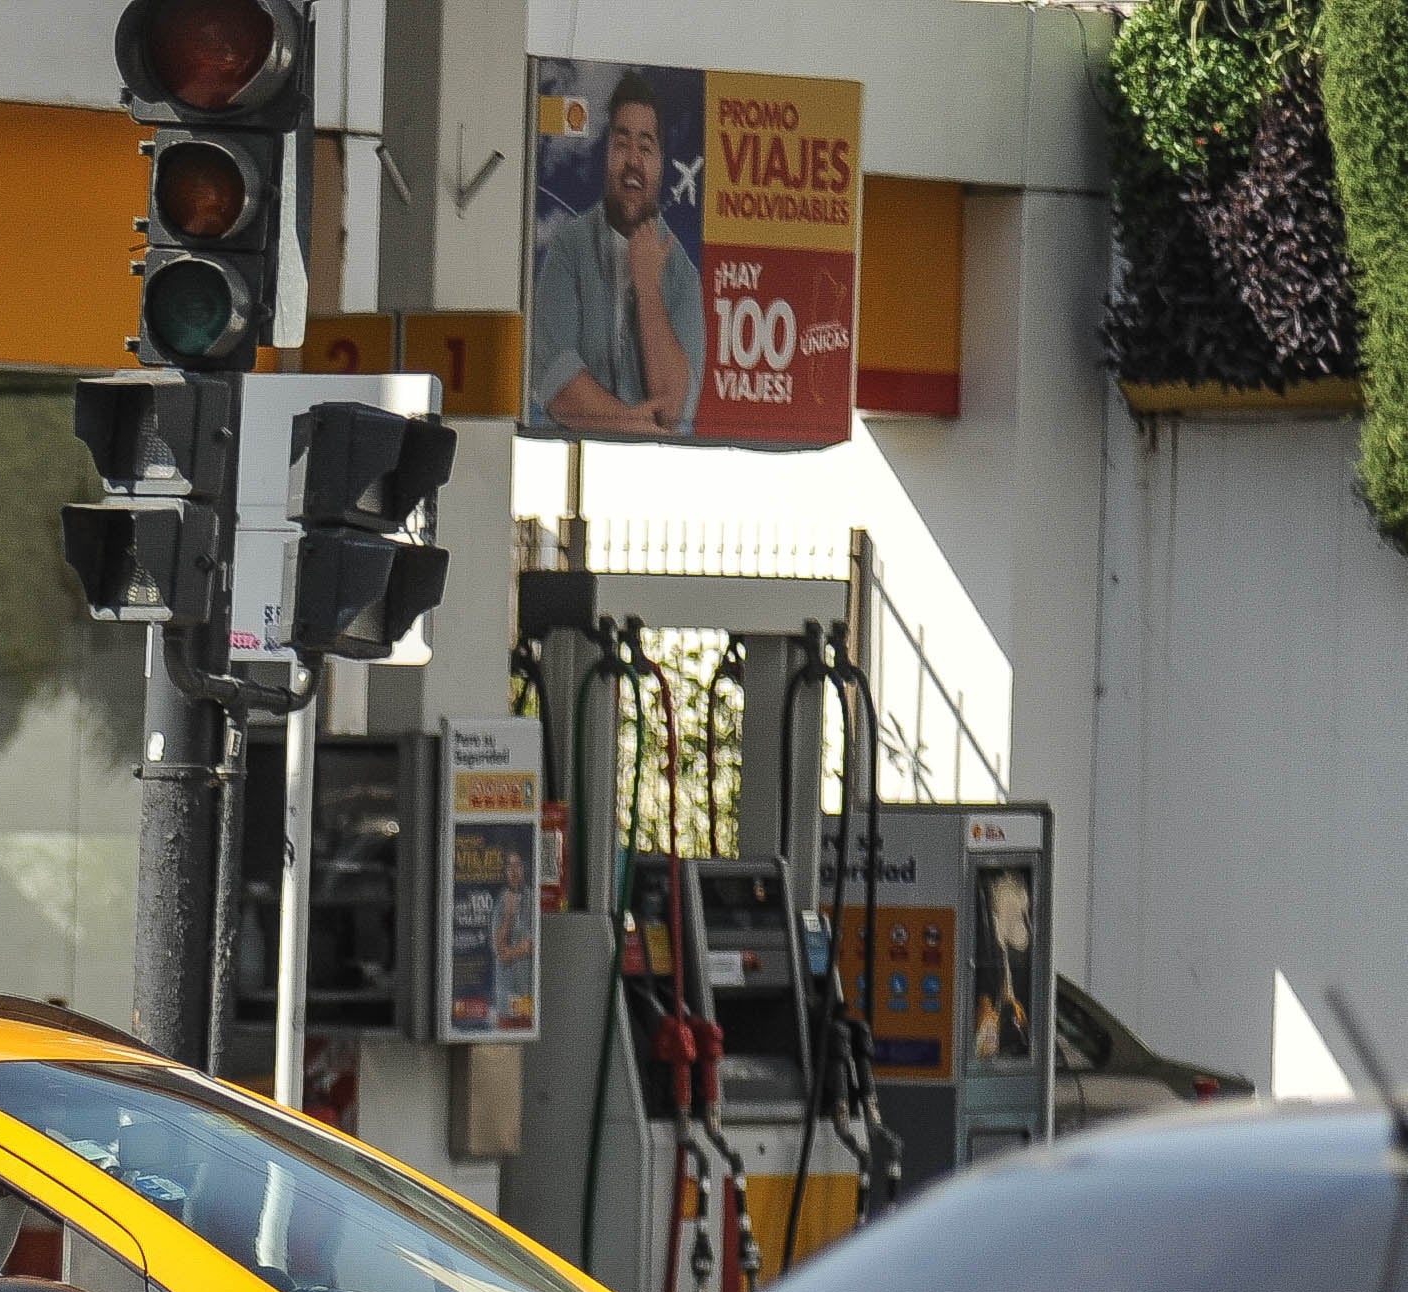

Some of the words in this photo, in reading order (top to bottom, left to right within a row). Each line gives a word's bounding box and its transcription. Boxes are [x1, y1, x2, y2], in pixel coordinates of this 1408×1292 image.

[719, 100, 800, 132] PROMO
[721, 132, 851, 192] VIAJES
[716, 190, 850, 225] INOLVIDABLES
[714, 261, 763, 295] ¡HAY
[713, 297, 798, 370] 100
[713, 369, 794, 404] VIAJES!
